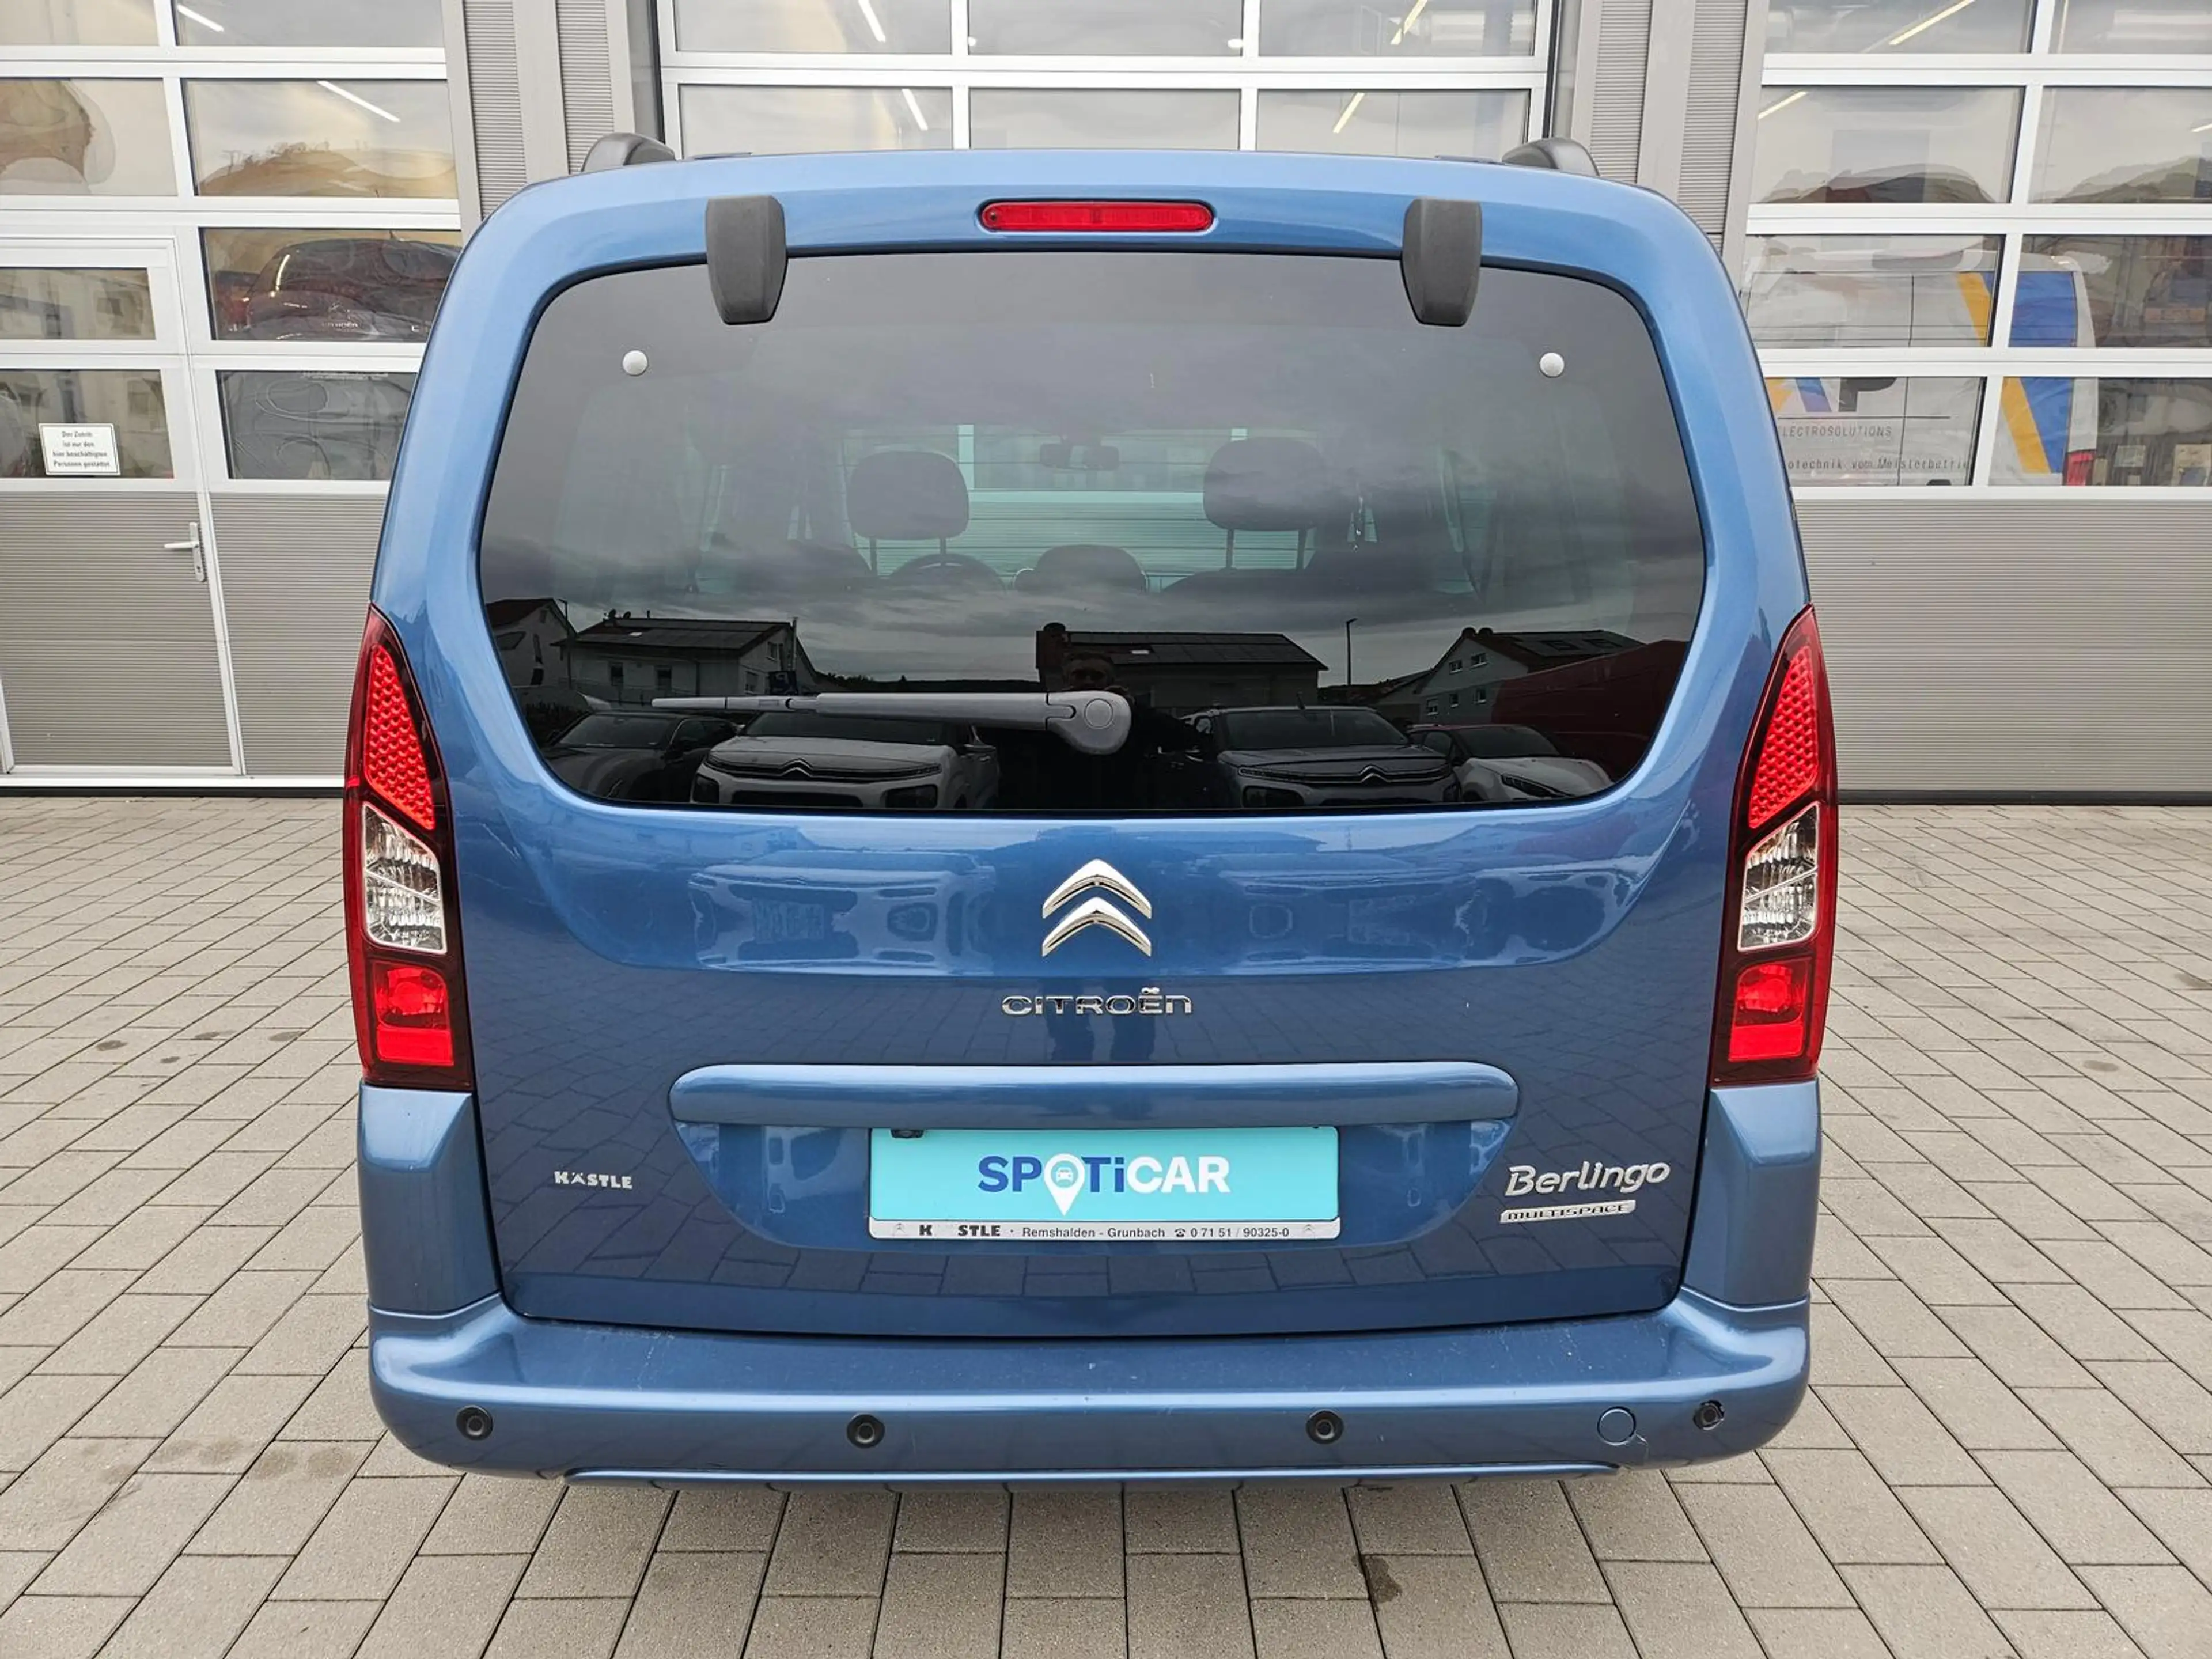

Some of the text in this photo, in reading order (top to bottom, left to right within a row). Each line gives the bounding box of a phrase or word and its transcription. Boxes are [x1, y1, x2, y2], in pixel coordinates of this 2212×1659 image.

[1779, 425, 1892, 437] LECTROSOLUTIONS
[554, 1171, 633, 1190] KÄSTLE
[1505, 1161, 1671, 1196] Berlingo
[1507, 1204, 1628, 1221] MULTISPACE
[1022, 1228, 1095, 1238] Remshalden
[1107, 1228, 1165, 1238] Grunbach
